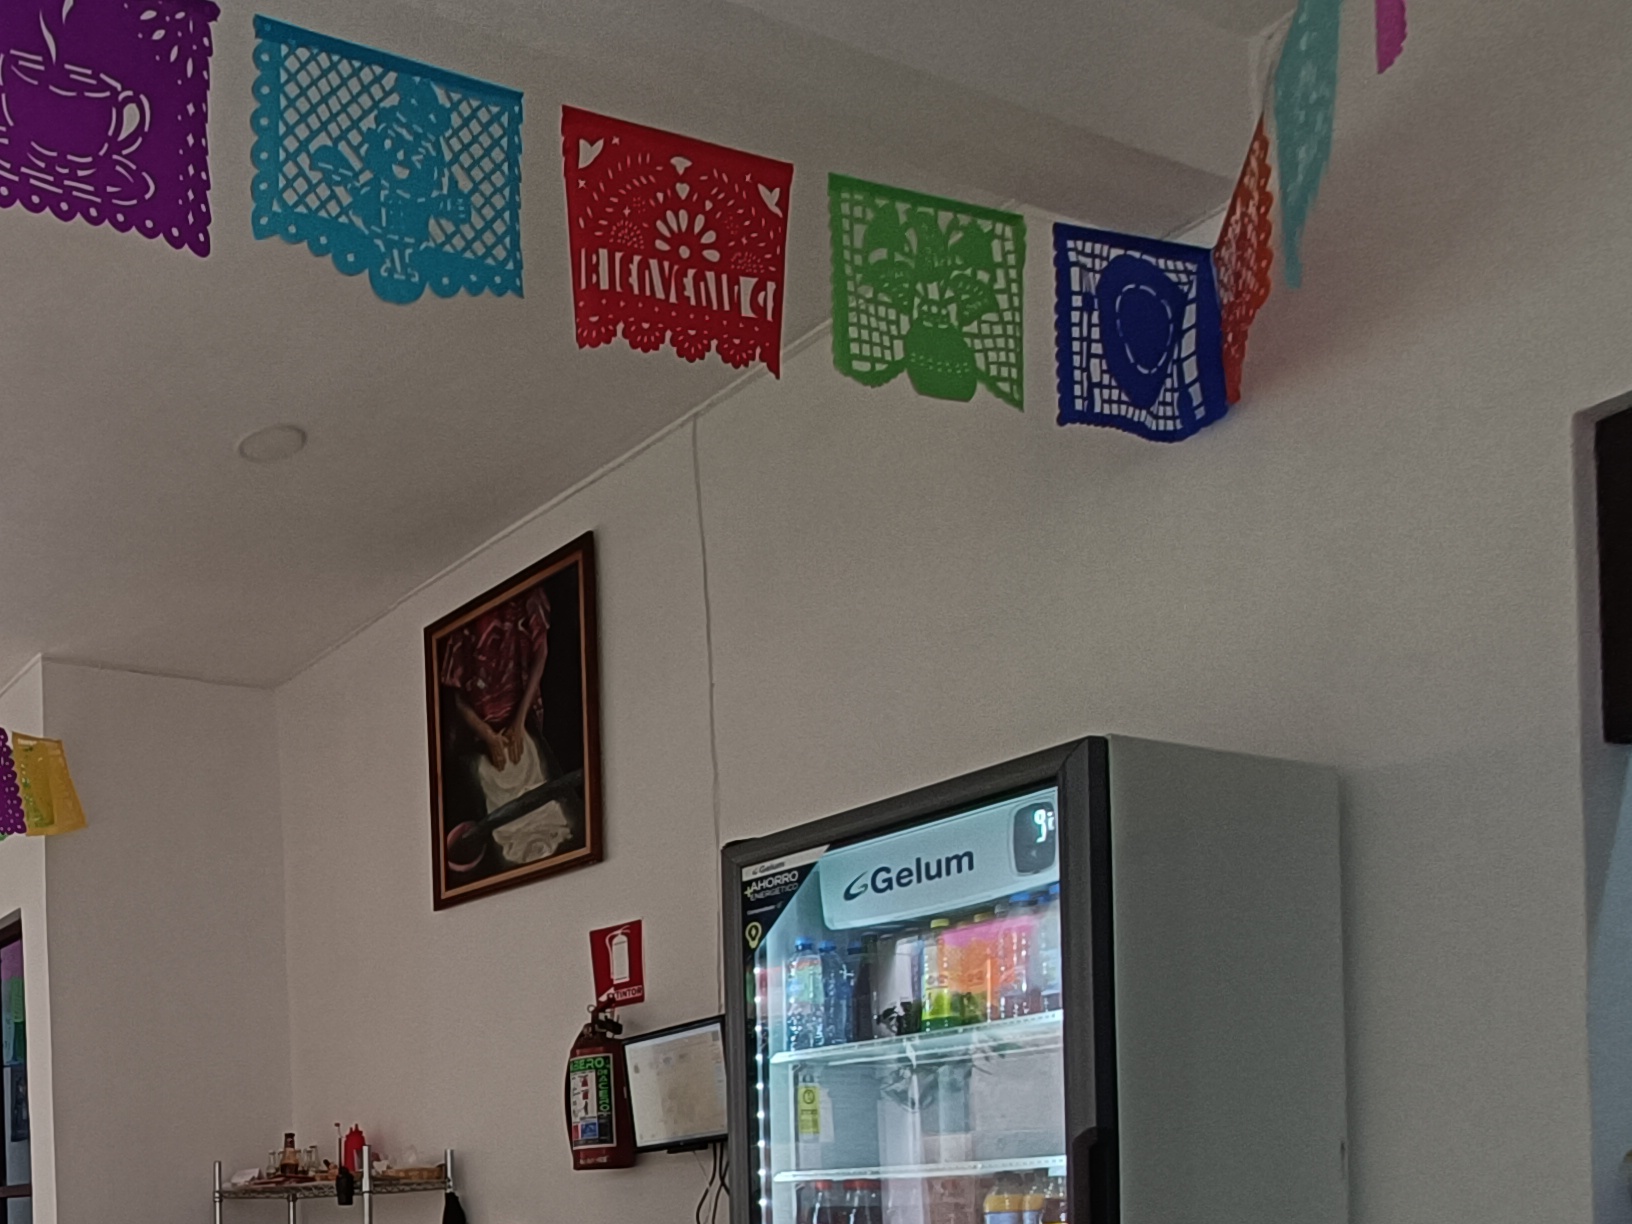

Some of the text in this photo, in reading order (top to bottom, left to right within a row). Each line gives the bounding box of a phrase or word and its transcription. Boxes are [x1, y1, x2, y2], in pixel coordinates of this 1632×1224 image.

[751, 870, 799, 891] AHORRO
[869, 849, 975, 894] Gelum
[615, 986, 642, 999] TINTOR
